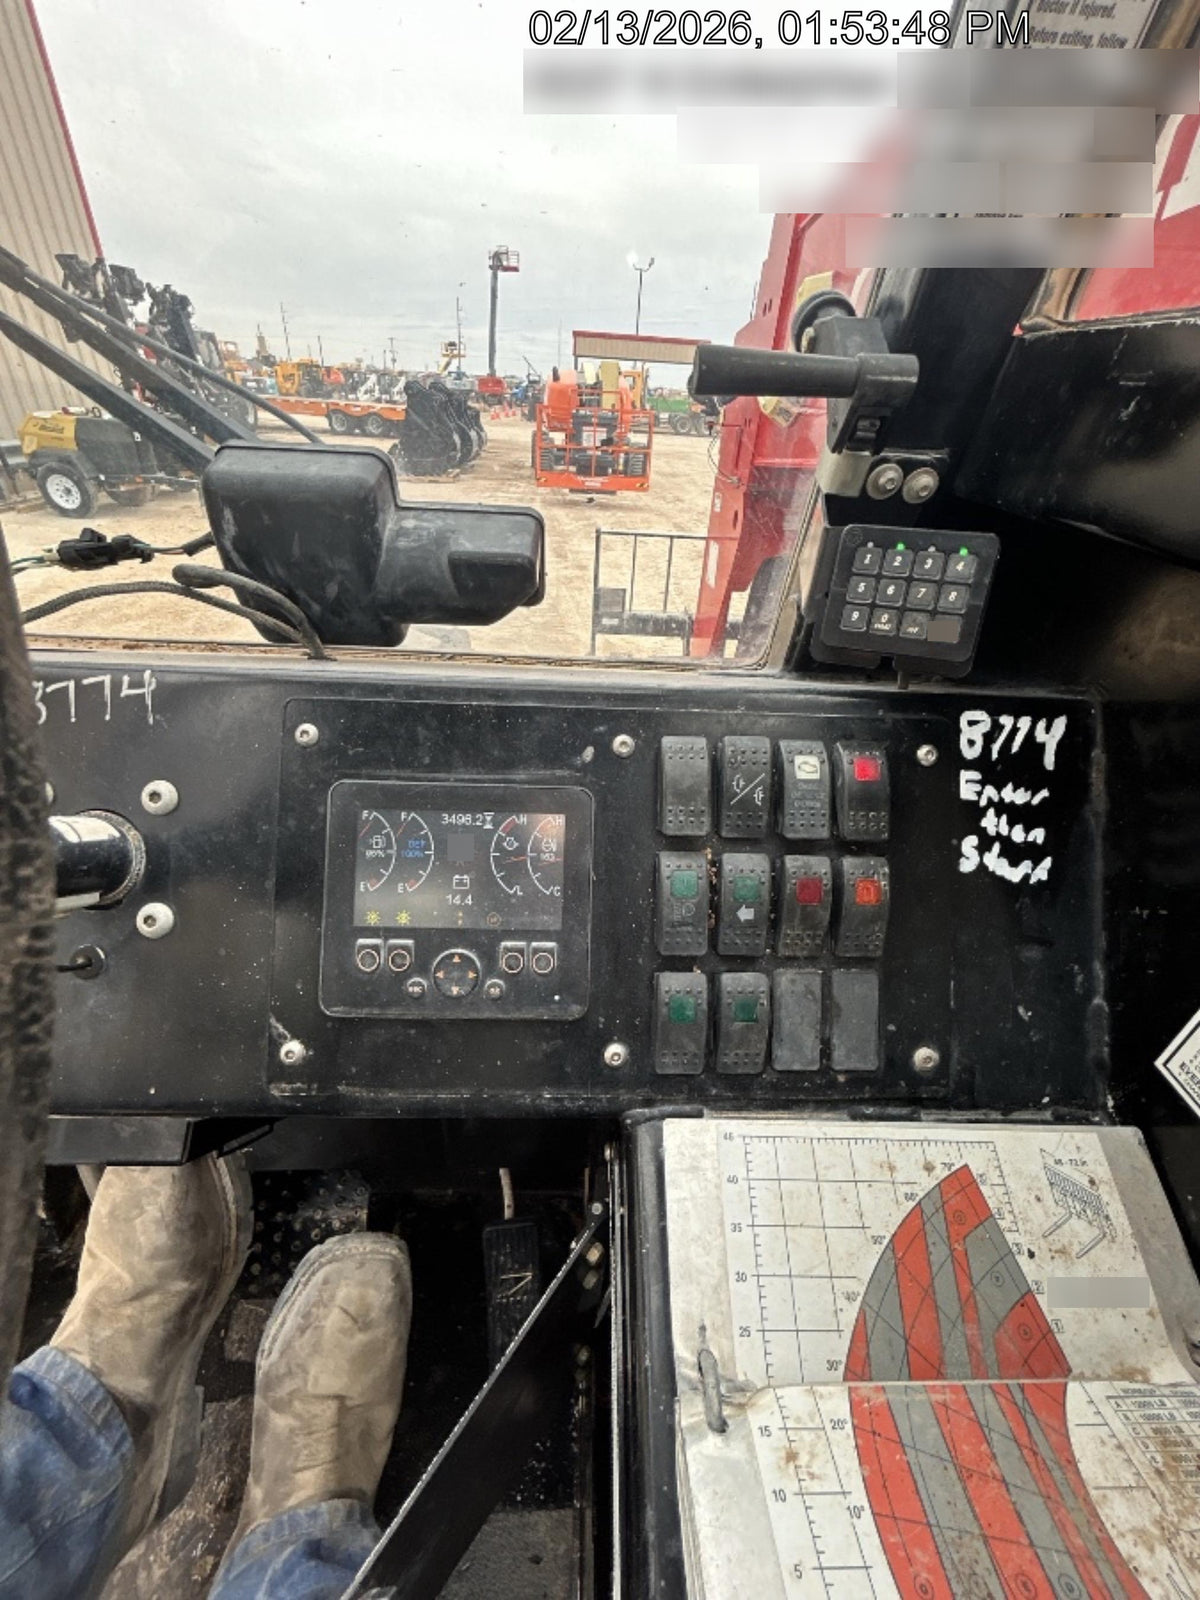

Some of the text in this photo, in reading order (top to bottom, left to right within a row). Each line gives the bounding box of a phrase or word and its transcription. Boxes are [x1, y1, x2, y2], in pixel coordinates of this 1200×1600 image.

[864, 554, 965, 571] 1 2 3 4
[858, 582, 957, 601] 5 6 7 8
[851, 611, 859, 621] 9
[362, 810, 369, 820] F
[401, 812, 407, 822] F
[360, 882, 366, 892] E
[398, 883, 404, 893] E
[446, 894, 473, 906] 14.4
[726, 1175, 739, 1185] 40
[739, 1325, 751, 1338] 25
[758, 1425, 772, 1437] 15
[772, 1489, 787, 1503] 10
[847, 1505, 865, 1519] 10°
[794, 1564, 803, 1579] 5
